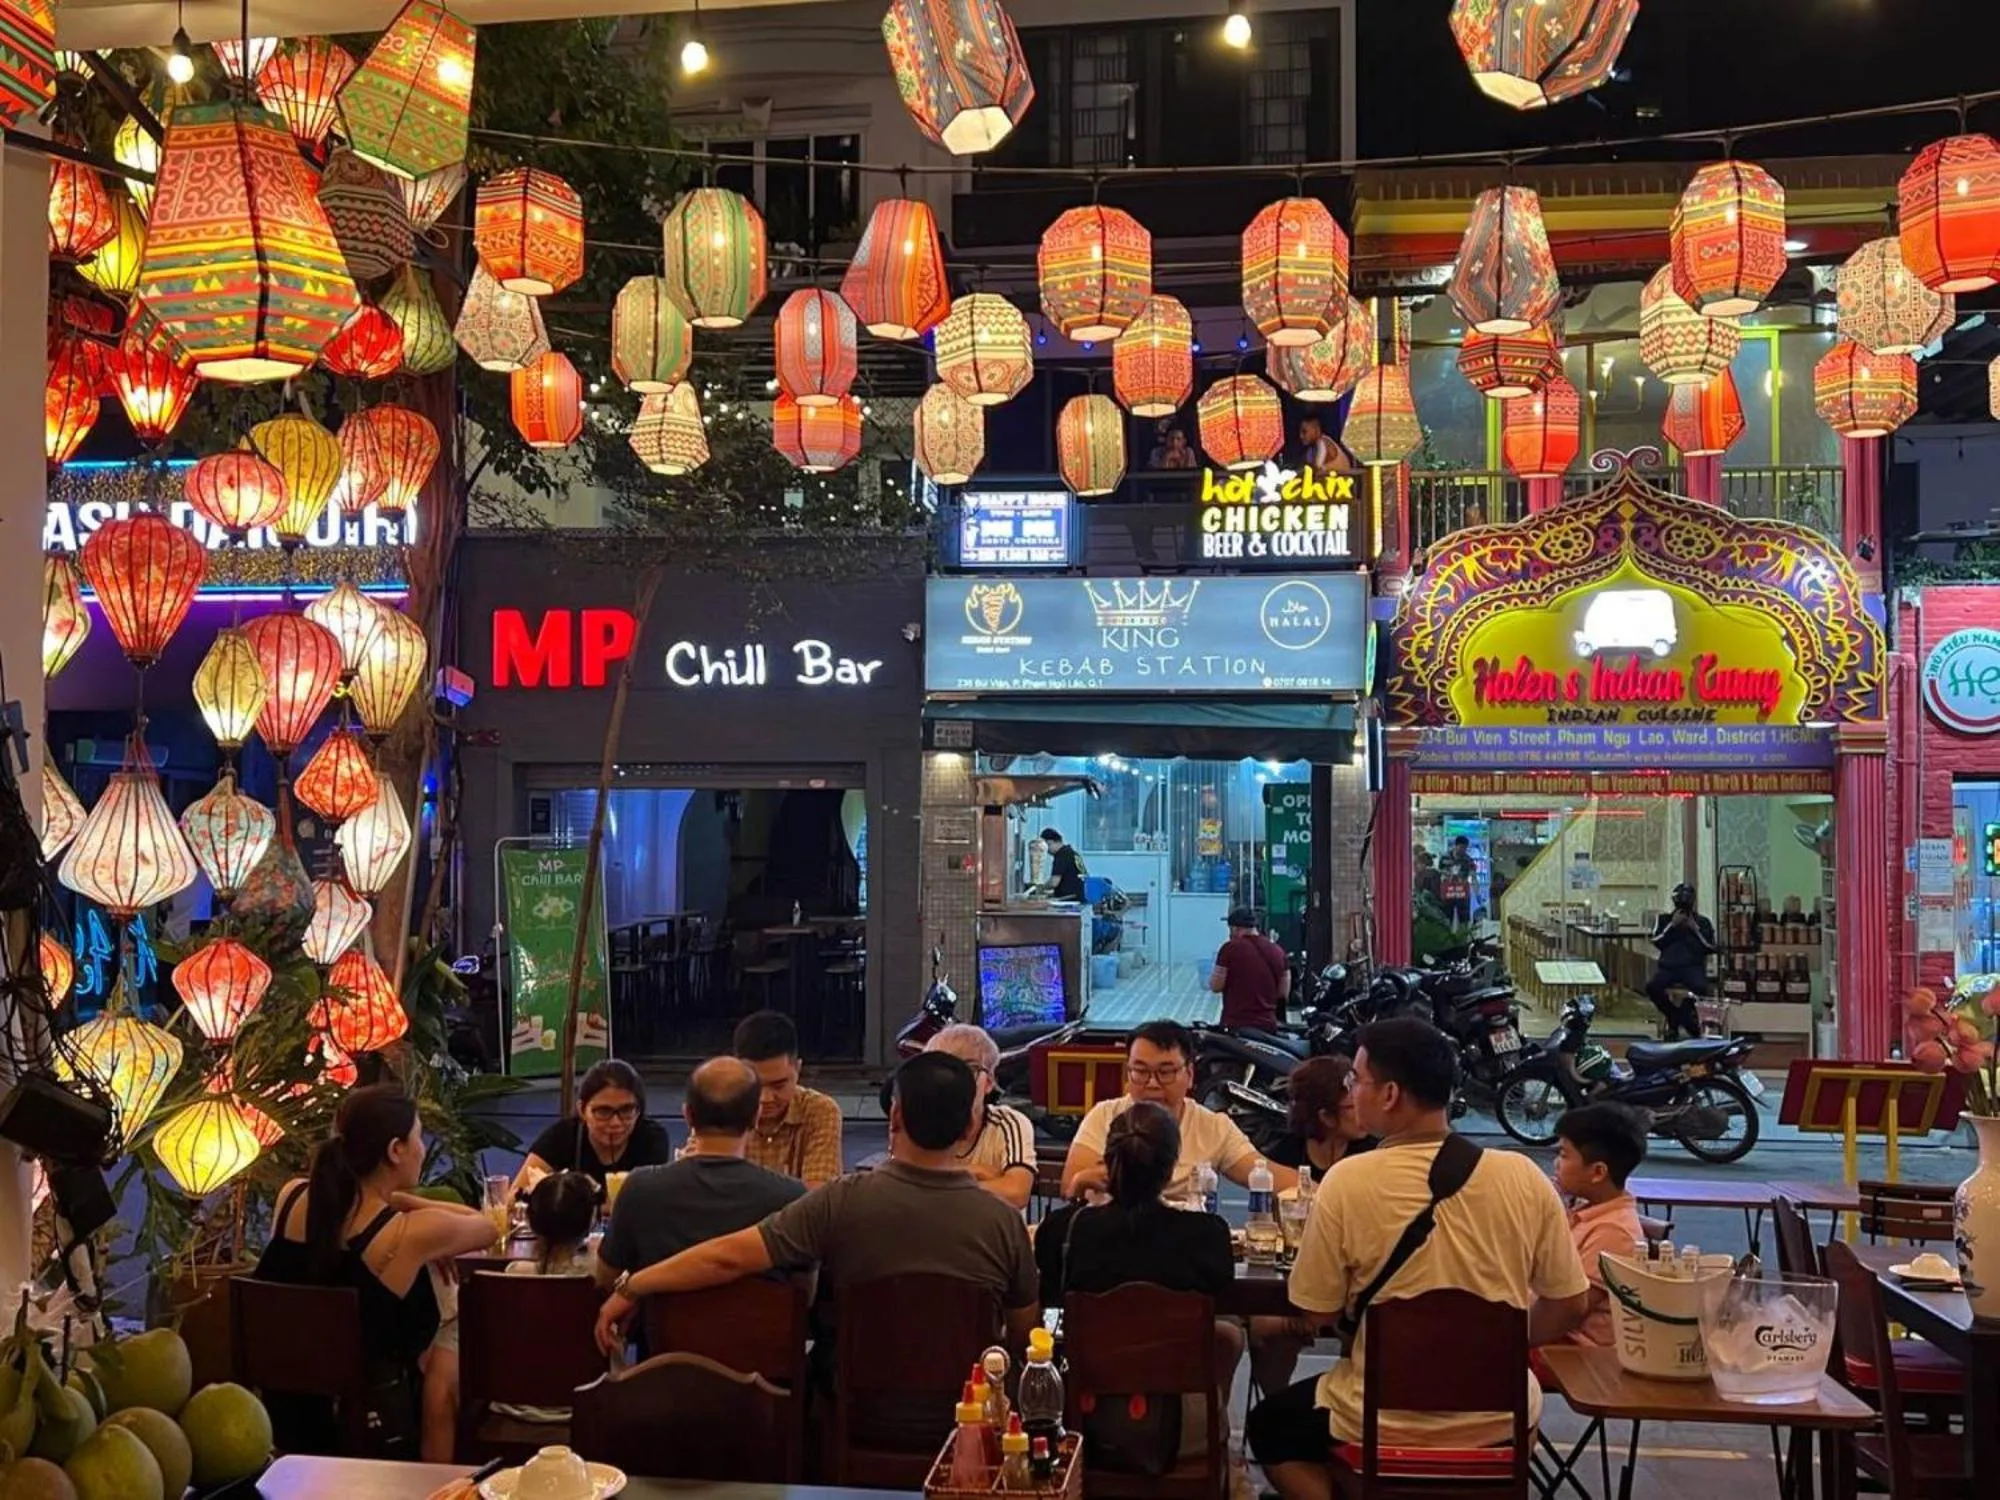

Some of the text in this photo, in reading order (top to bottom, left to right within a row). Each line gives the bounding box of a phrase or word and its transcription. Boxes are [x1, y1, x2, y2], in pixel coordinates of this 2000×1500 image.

[1202, 464, 1354, 503] hot chix
[1202, 504, 1350, 532] CHICKEN
[1203, 530, 1351, 558] BEER & COCKTAIL
[1268, 616, 1323, 628] HALAL
[493, 609, 637, 688] MP
[1102, 628, 1180, 652] KING
[665, 639, 883, 688] Chill Bar
[1019, 655, 1267, 676] KEBAB STATION
[1546, 706, 1717, 723] INDIAN CUISINE
[1446, 728, 1467, 746] Bui
[1604, 729, 1631, 750] Ngu
[1717, 727, 1765, 746] District
[538, 859, 565, 873] MP
[1755, 1325, 1818, 1351] Carlsberg
